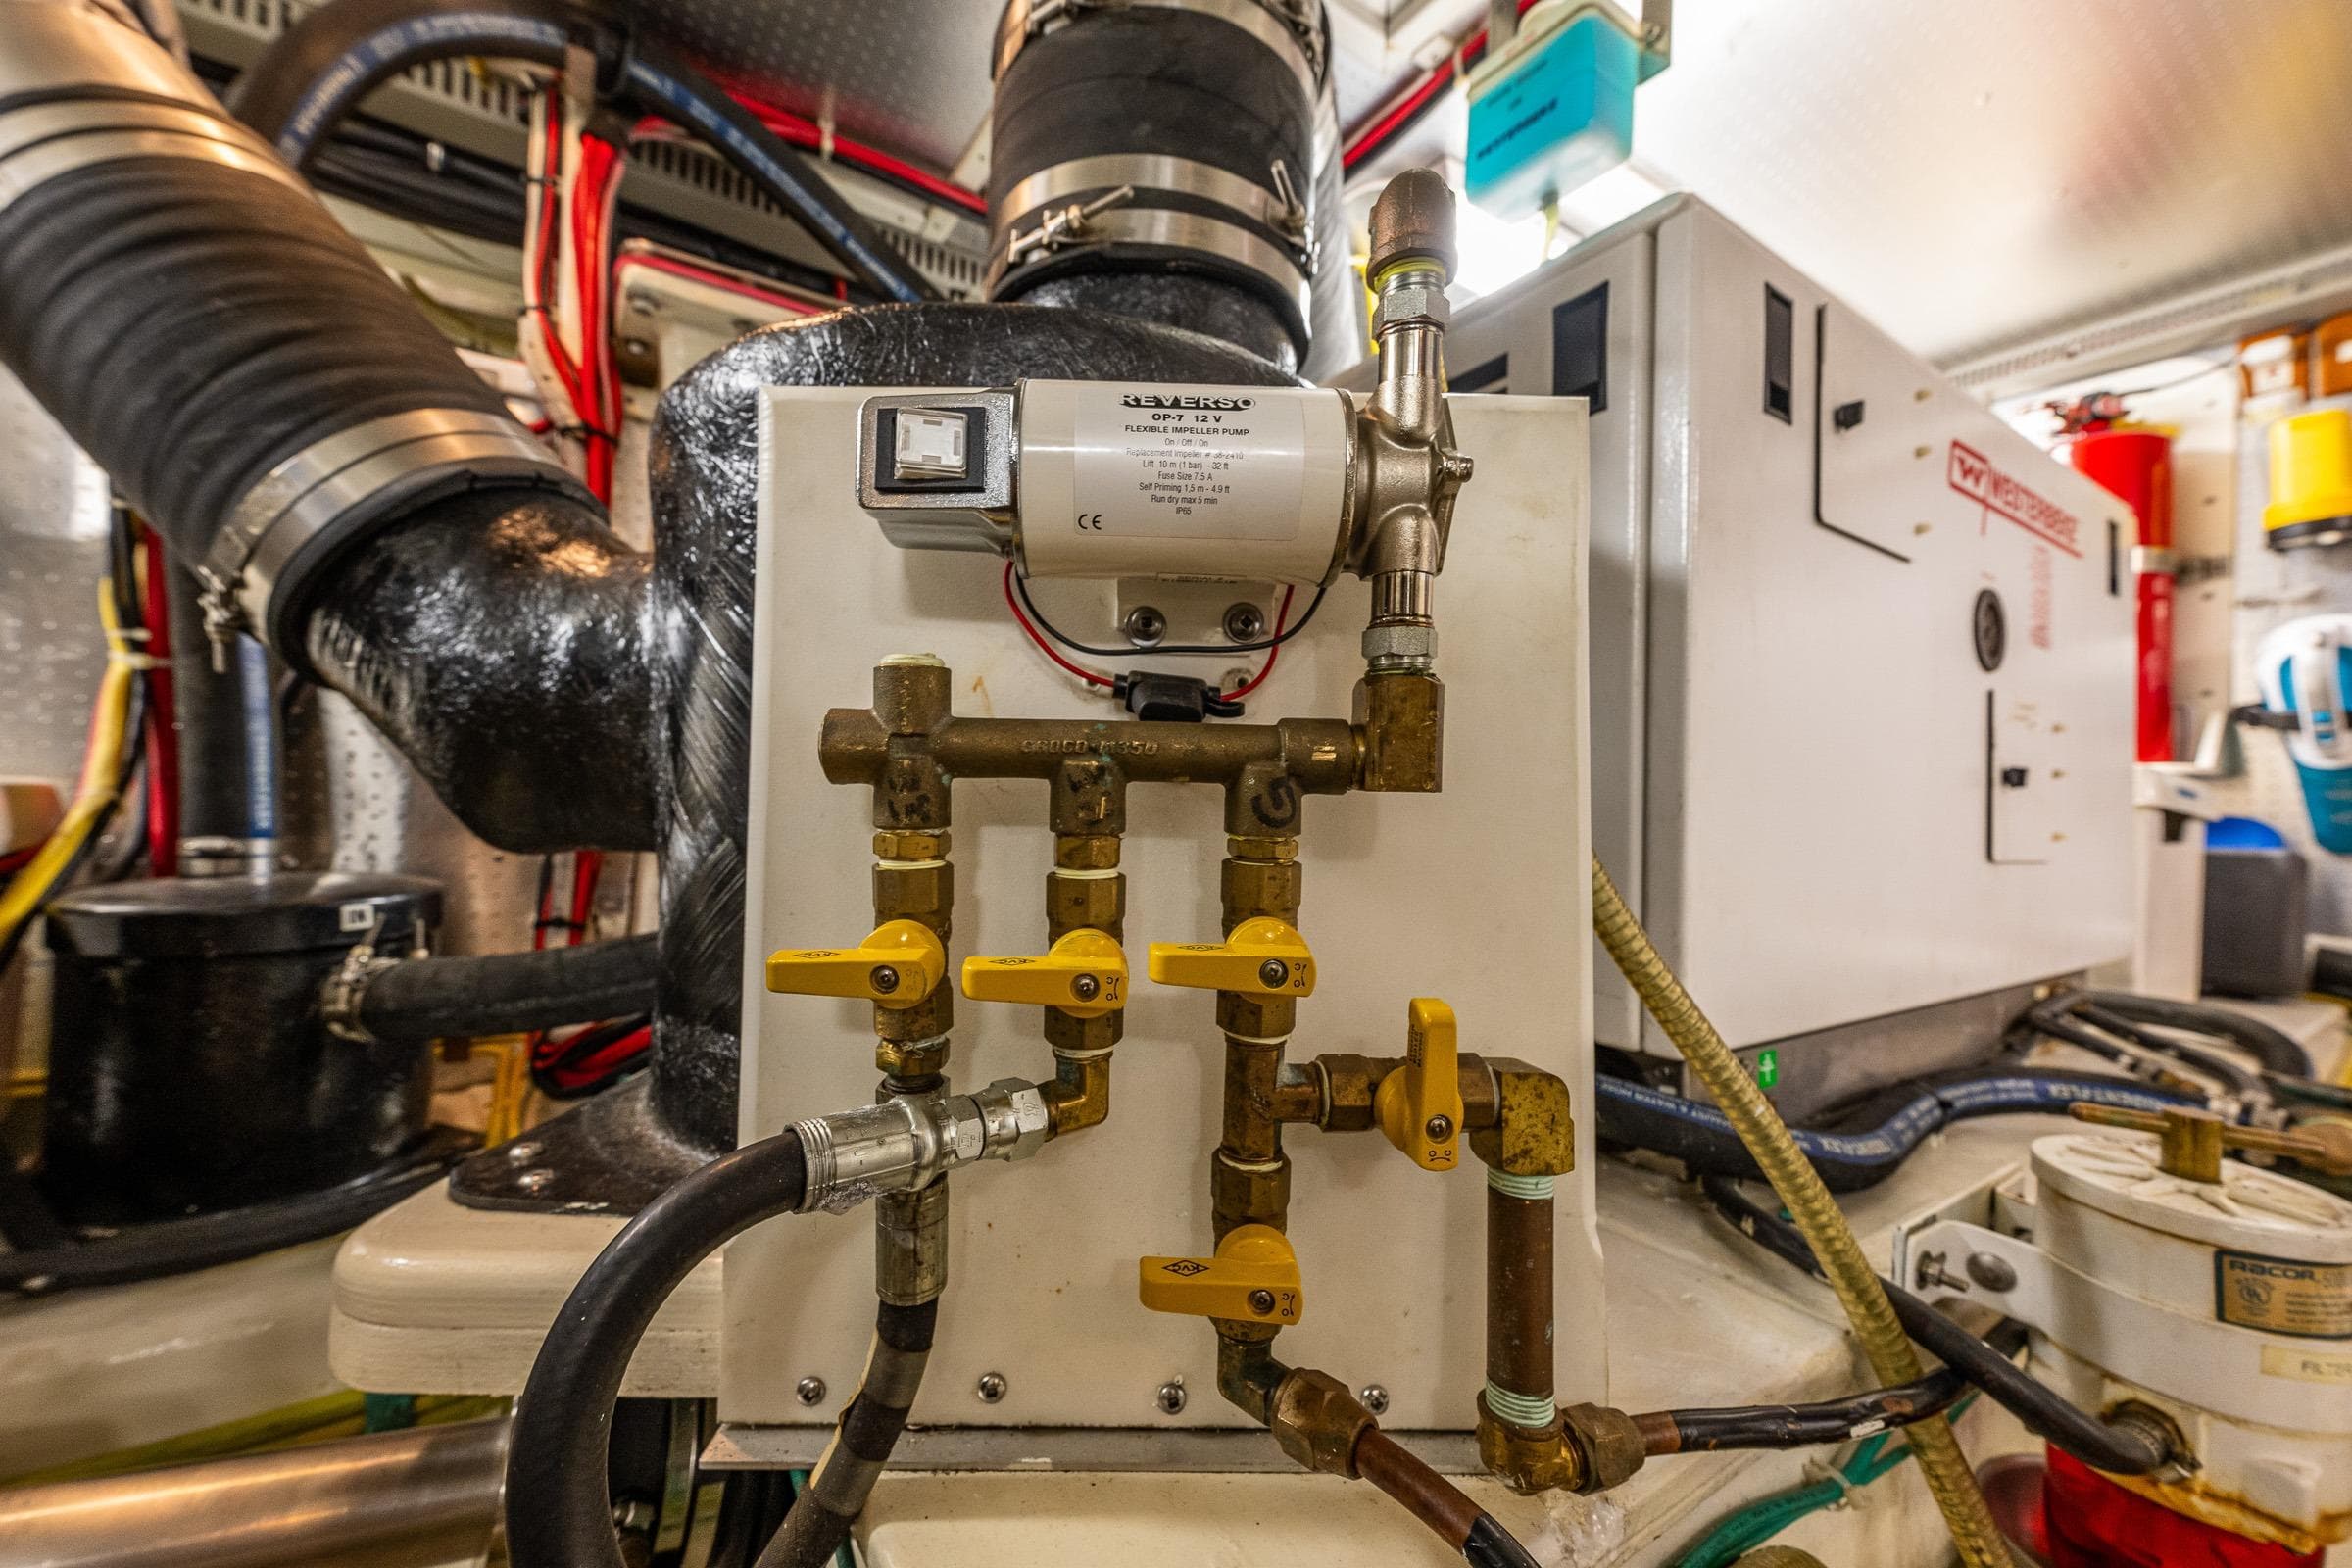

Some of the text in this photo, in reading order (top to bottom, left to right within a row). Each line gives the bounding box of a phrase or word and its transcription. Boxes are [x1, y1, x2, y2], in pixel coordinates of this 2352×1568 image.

[1120, 394, 1256, 411] REVERSO
[1152, 413, 1184, 422] OP-7
[1125, 424, 1169, 434] FLEXIBLE
[1172, 426, 1219, 435] IMPELLER
[1143, 460, 1154, 468] Lift
[1211, 462, 1221, 470] 32
[1157, 471, 1175, 480] Fuse
[1139, 482, 1152, 491] Self
[1154, 482, 1182, 493] Priming
[1167, 495, 1179, 505] dry
[1203, 496, 1218, 505] min
